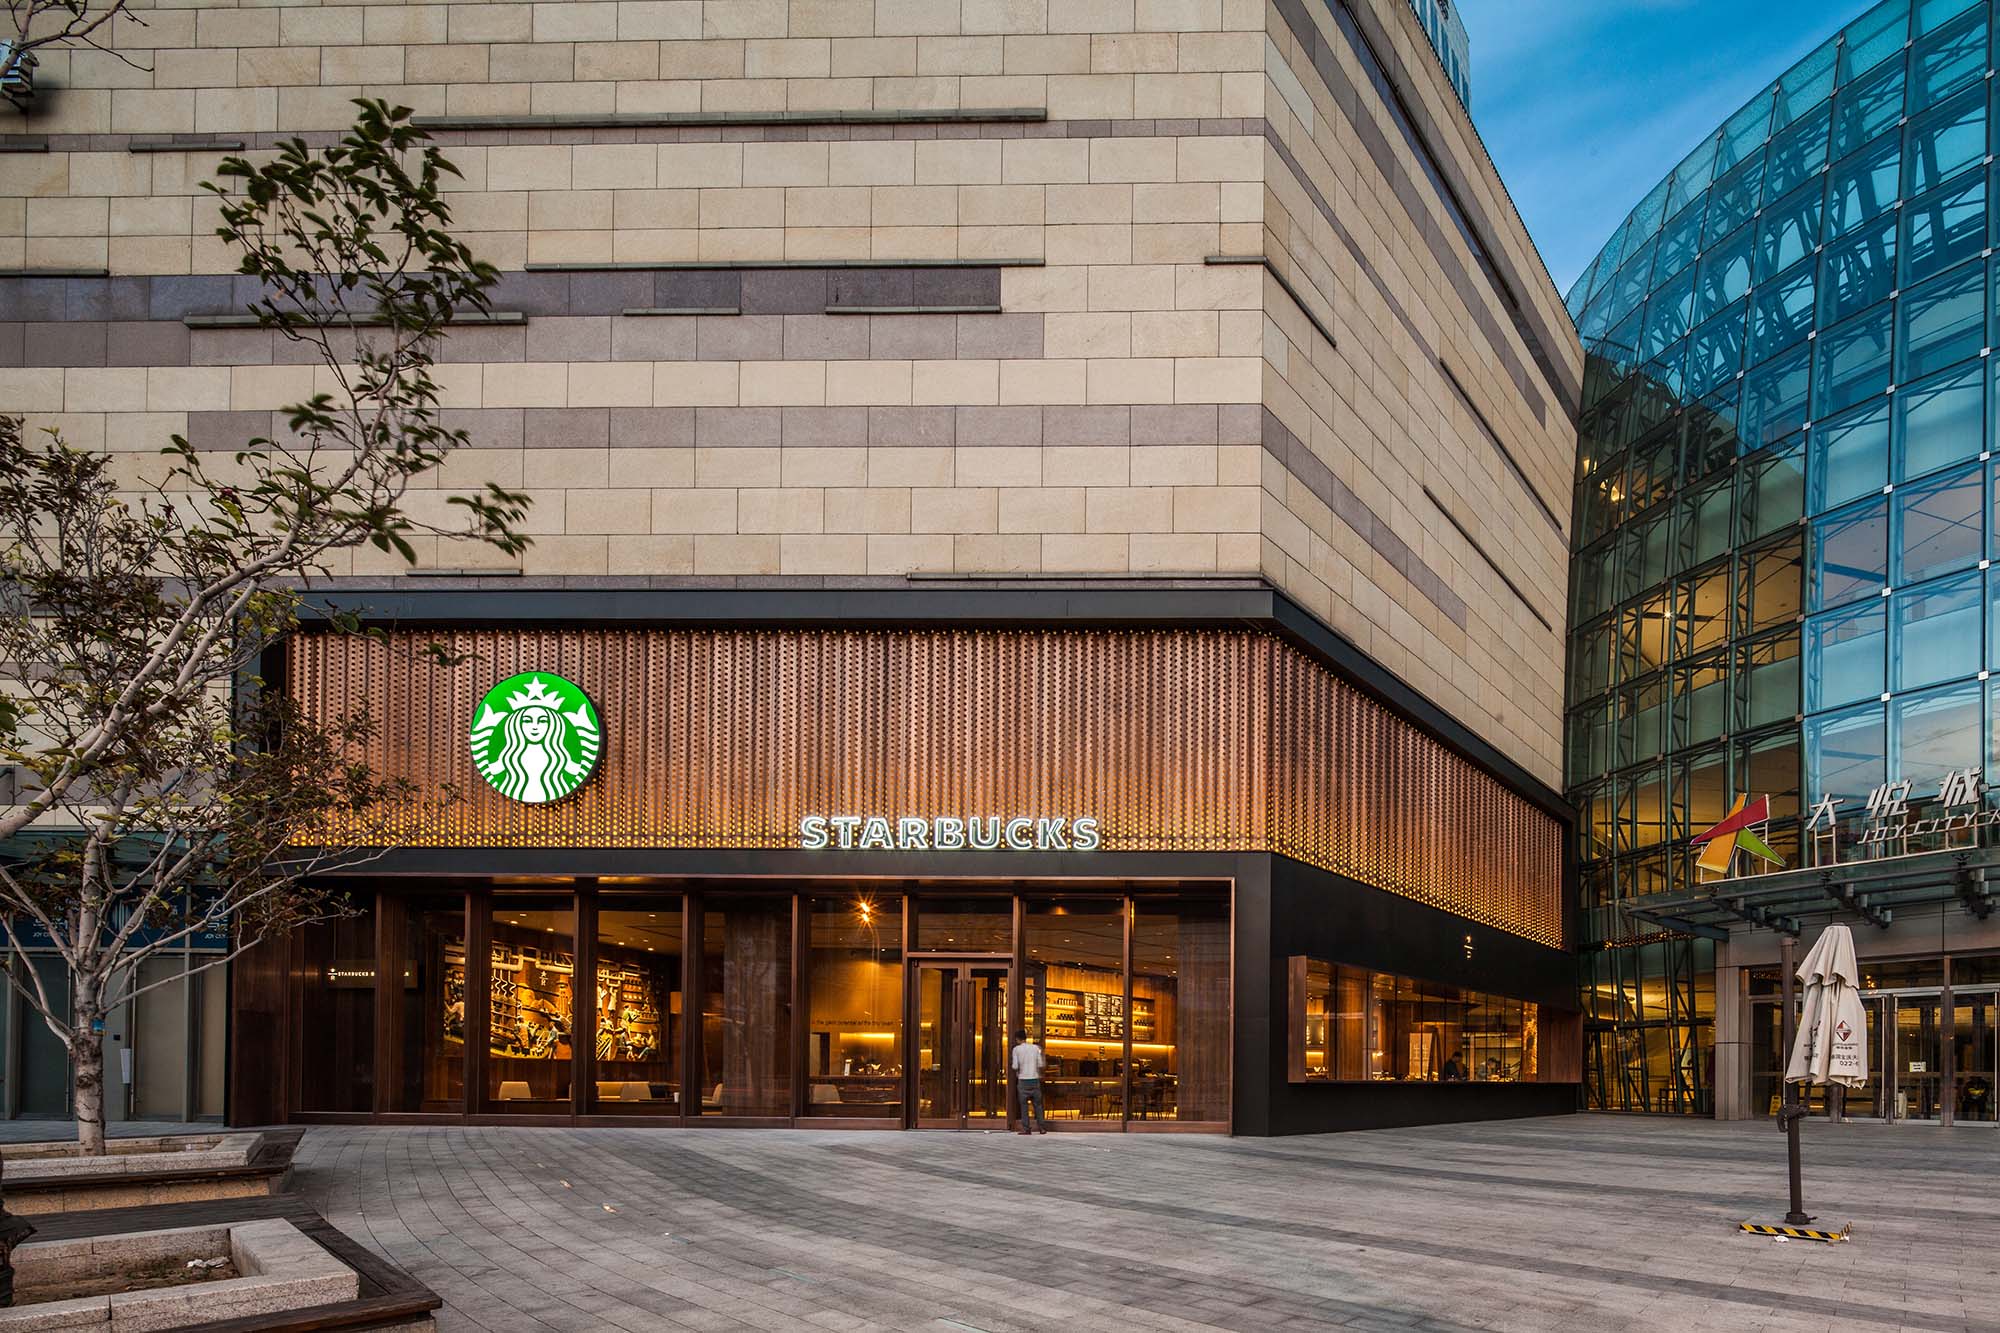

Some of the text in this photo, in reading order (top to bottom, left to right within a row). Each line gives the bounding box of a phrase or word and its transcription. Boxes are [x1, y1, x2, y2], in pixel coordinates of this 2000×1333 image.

[1807, 766, 1982, 831] 大悦城
[800, 816, 1100, 850] STARBUCKS
